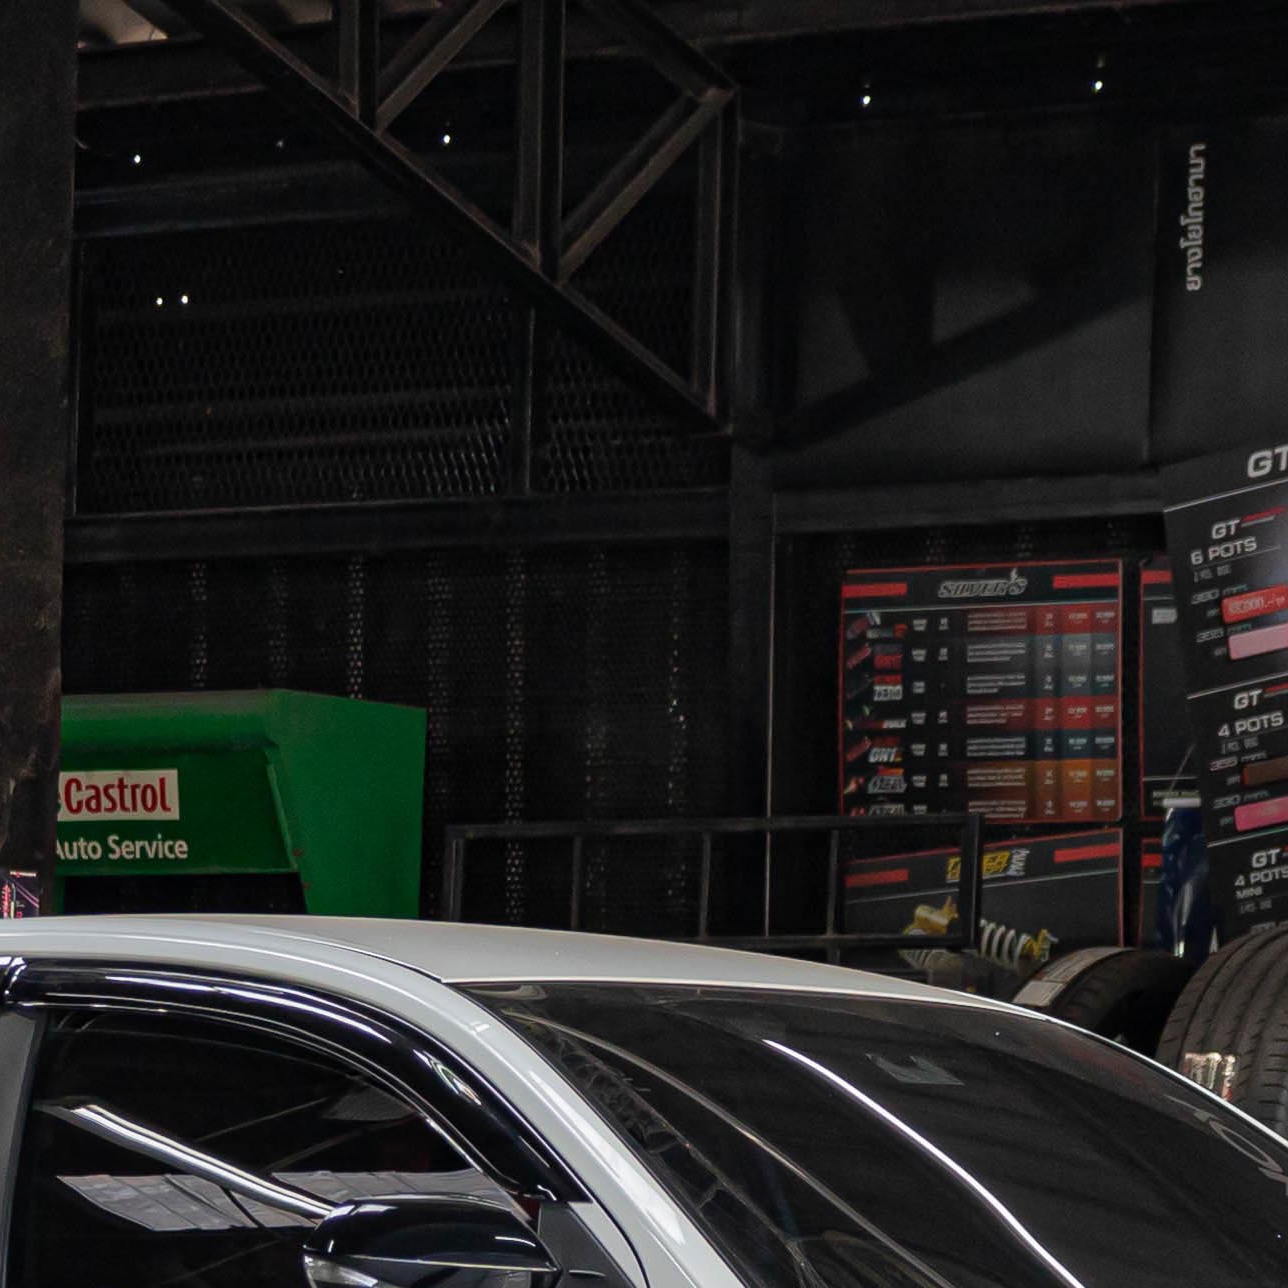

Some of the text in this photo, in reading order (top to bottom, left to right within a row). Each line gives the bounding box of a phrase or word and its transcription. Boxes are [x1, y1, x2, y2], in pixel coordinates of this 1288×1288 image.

[1211, 520, 1241, 540] GT
[1207, 536, 1258, 562] POTS
[1233, 688, 1263, 710] GT
[1217, 711, 1285, 738] 4 POTS
[64, 774, 171, 816] Castrol
[107, 834, 189, 860] Service
[1251, 848, 1281, 869] GT
